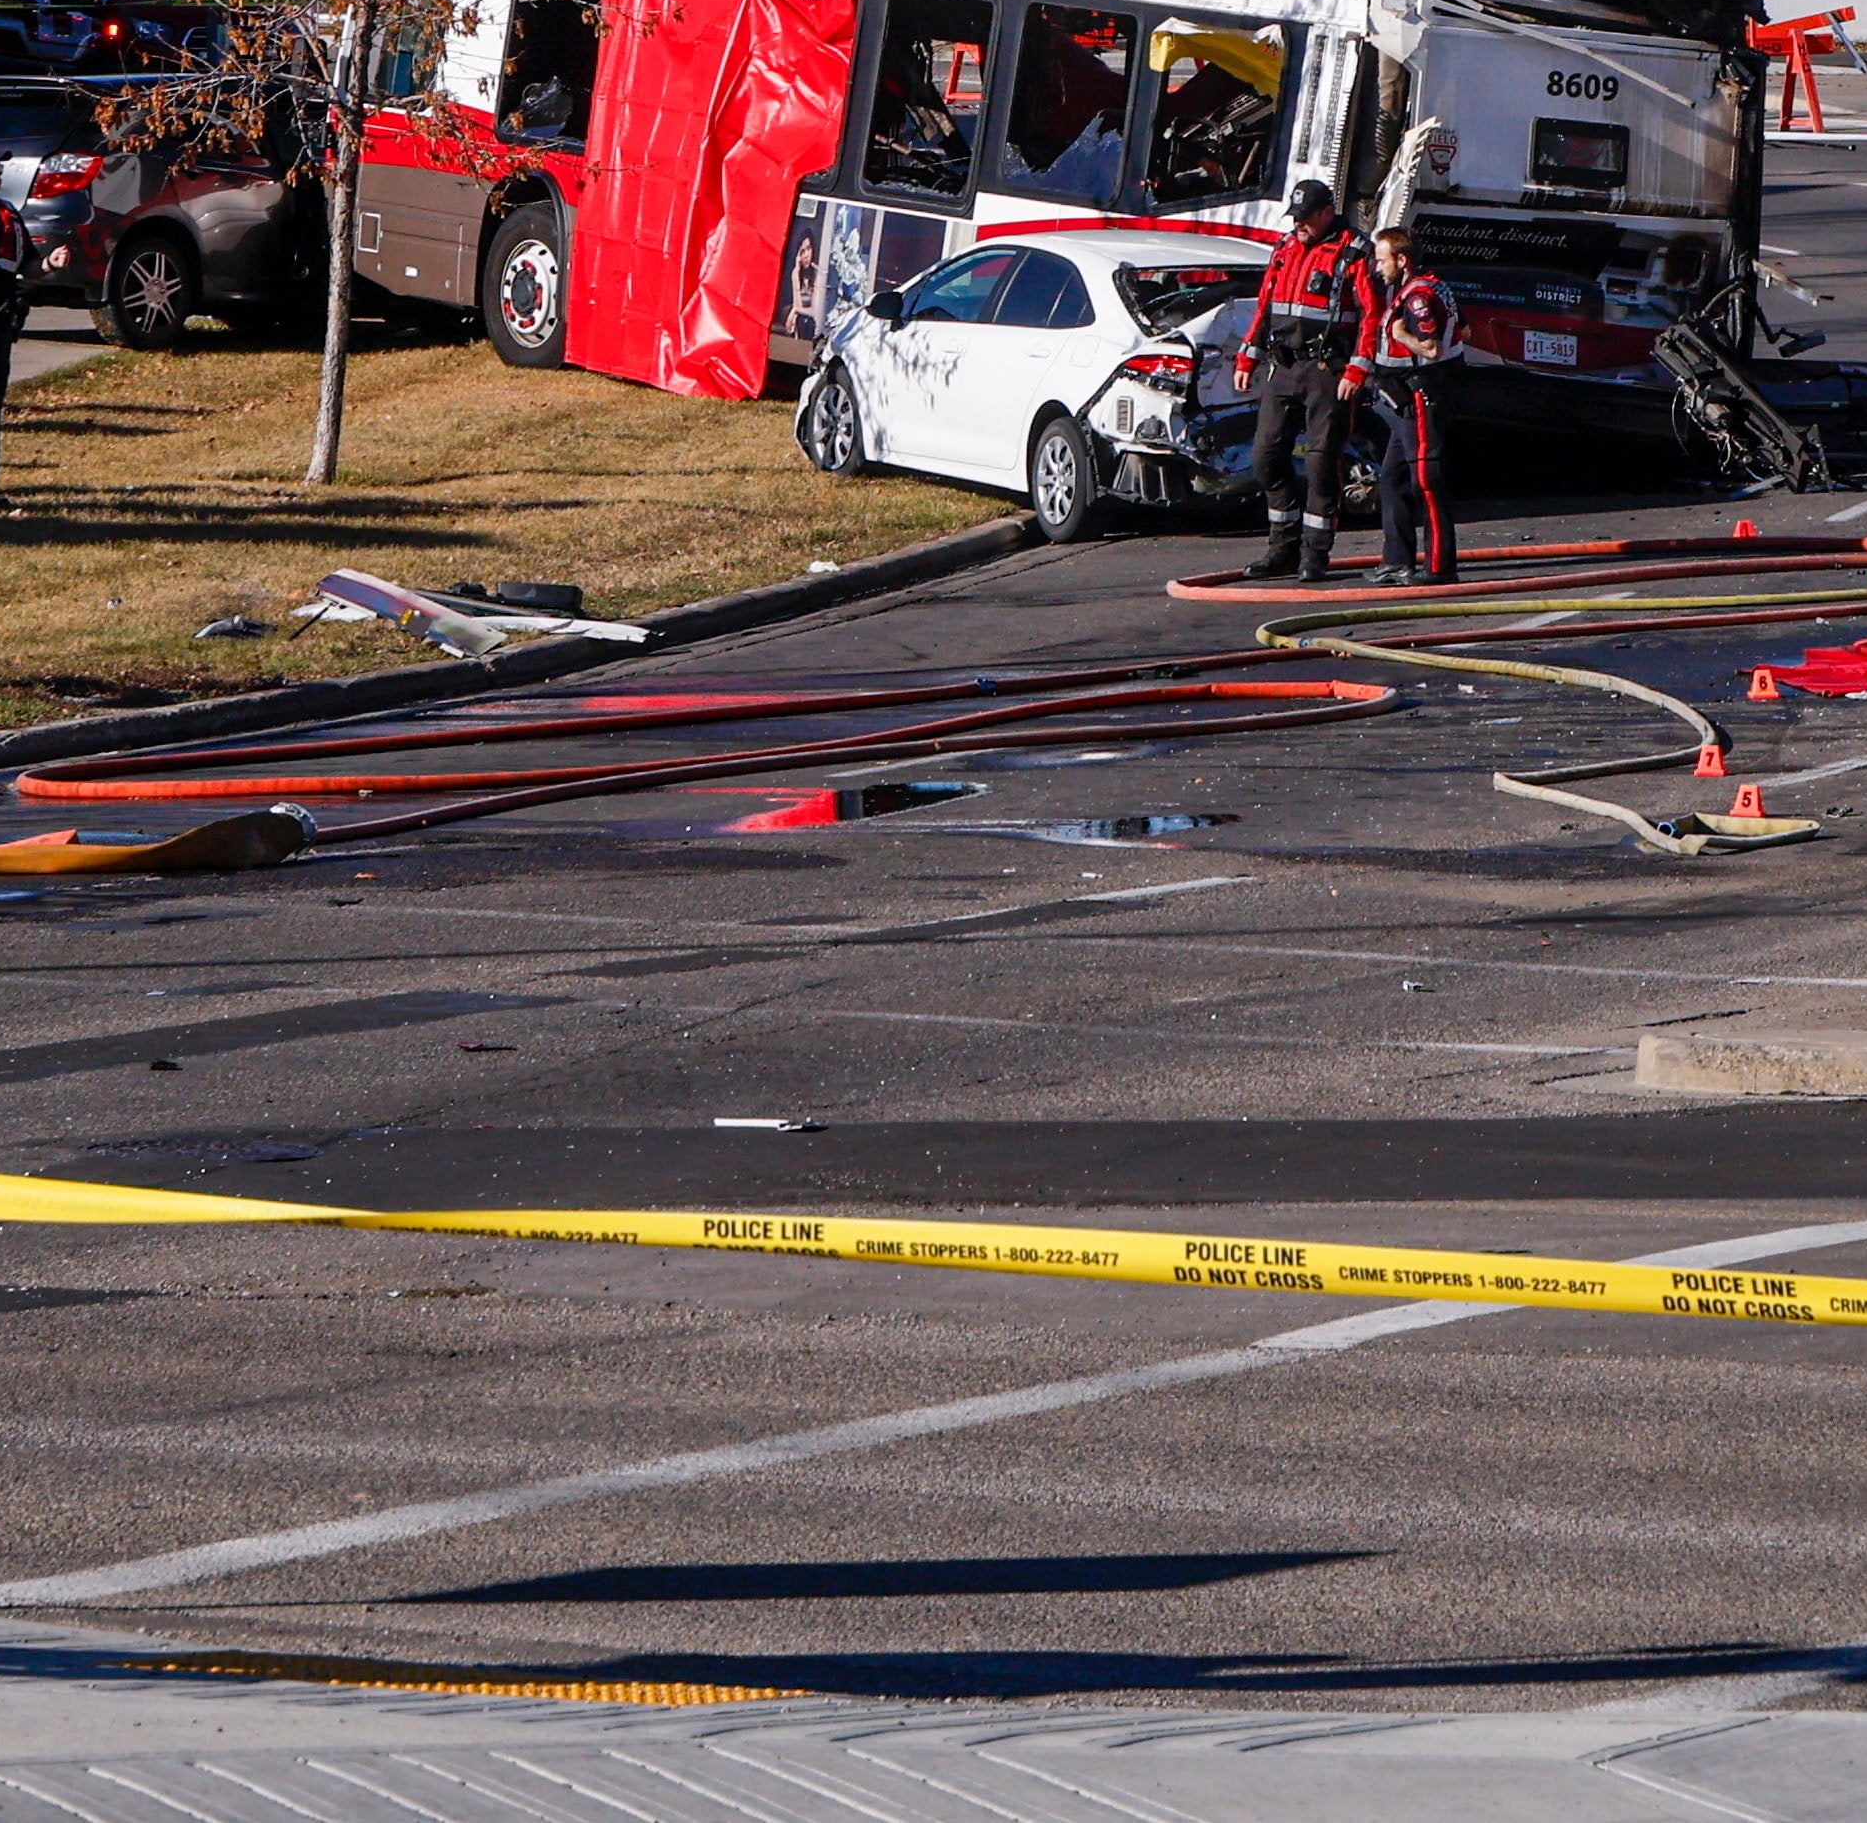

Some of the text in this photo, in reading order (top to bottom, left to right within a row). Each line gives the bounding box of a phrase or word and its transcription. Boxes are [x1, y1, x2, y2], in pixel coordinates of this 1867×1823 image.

[1546, 71, 1619, 101] 8609
[1536, 290, 1582, 304] DISTRICT
[1526, 340, 1575, 358] CXT-5819
[1705, 753, 1714, 767] 7
[1741, 792, 1751, 808] 5
[704, 1219, 825, 1242] POLICE LINE
[856, 1239, 904, 1257] CRIME
[910, 1242, 988, 1261] STOPPERS
[994, 1246, 1120, 1268] 1-800-222-8477
[1185, 1241, 1307, 1267] POLICE LINE
[1174, 1266, 1323, 1290] DO NOT CROSS
[1339, 1265, 1606, 1296] CRIME STOPPERS 1-800-222-8477
[1672, 1272, 1797, 1298] POLICE LINE
[1662, 1295, 1814, 1322] DO NOT CROSS
